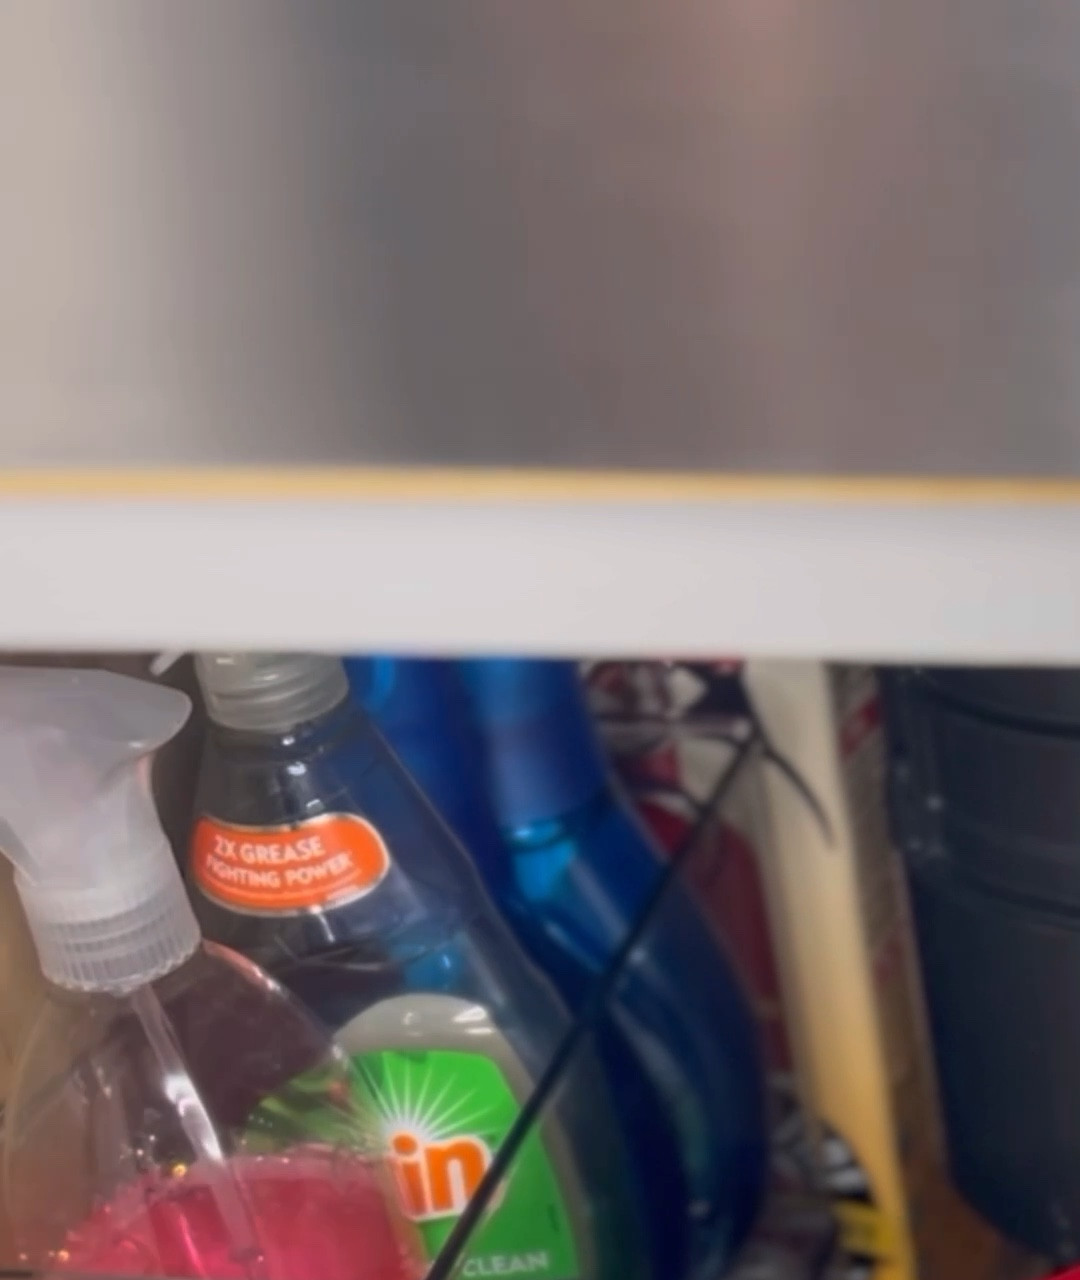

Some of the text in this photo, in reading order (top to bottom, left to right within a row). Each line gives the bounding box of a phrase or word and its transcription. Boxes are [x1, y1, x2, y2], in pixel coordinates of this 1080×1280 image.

[239, 835, 326, 866] GREASE
[283, 850, 355, 887] POWER
[463, 1252, 548, 1277] CLEAN
